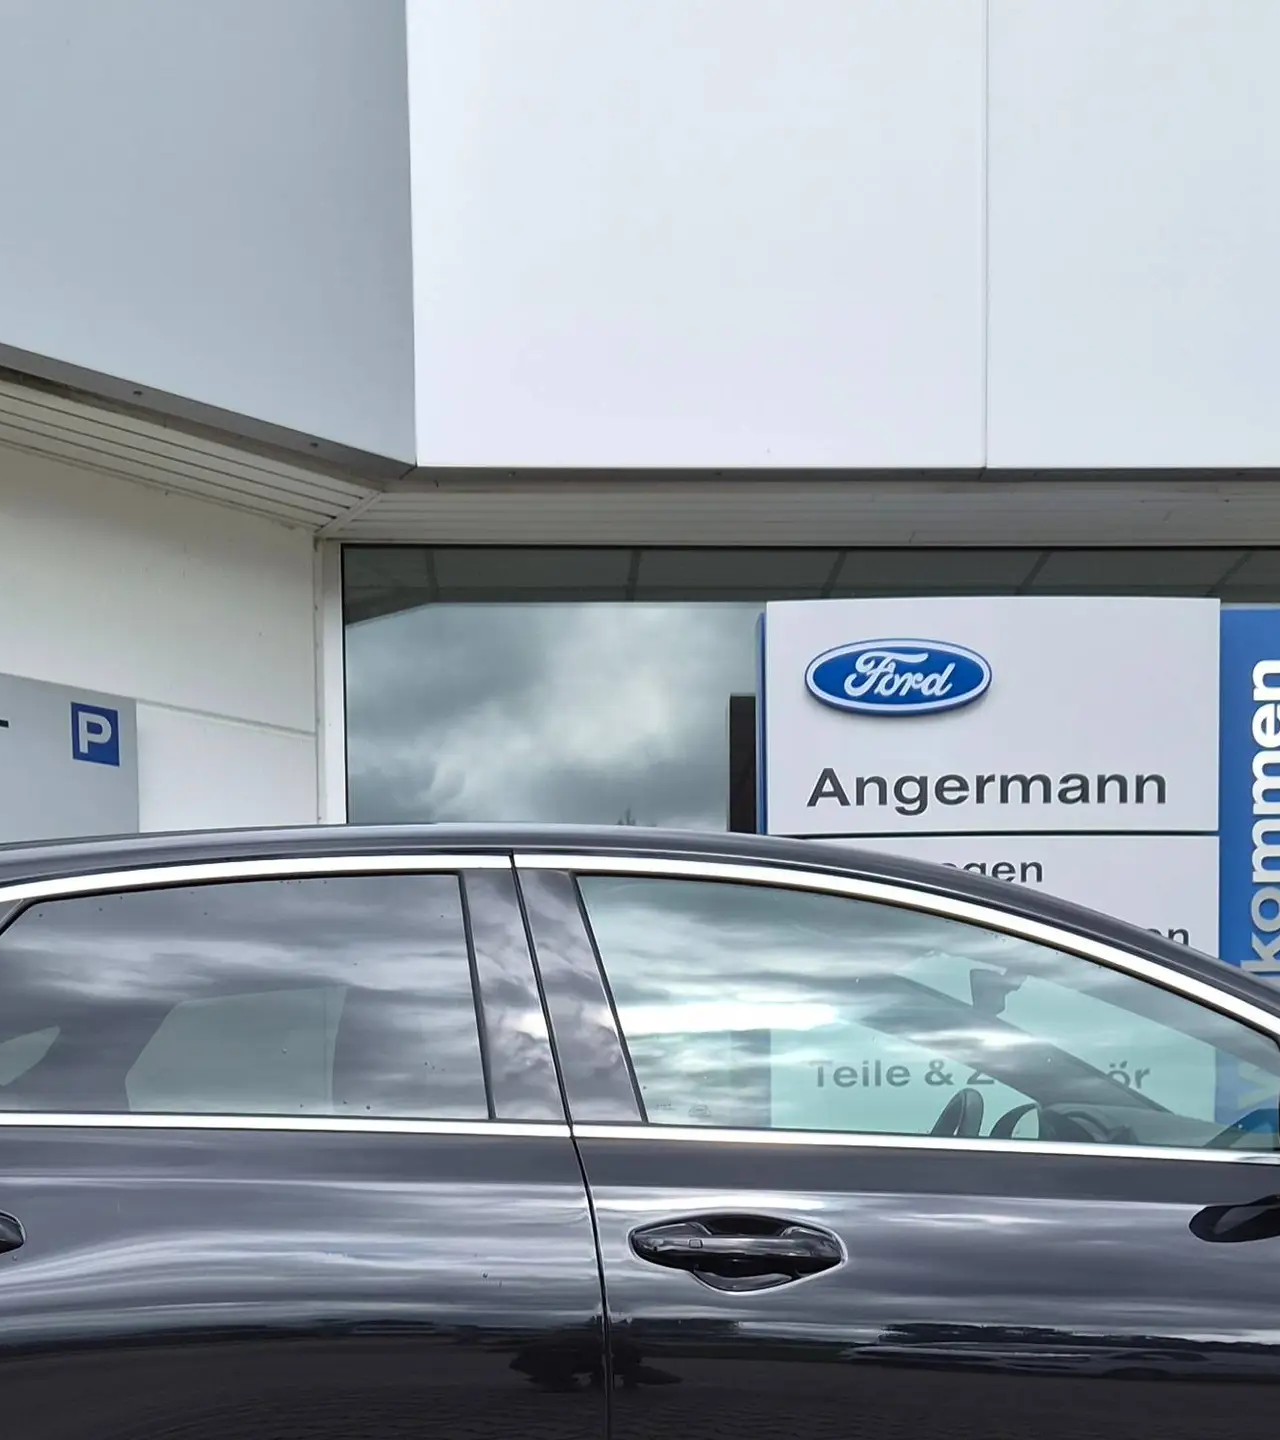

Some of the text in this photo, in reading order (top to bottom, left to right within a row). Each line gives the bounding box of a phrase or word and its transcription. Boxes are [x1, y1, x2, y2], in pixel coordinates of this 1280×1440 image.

[844, 652, 957, 699] Ford
[807, 768, 1167, 815] Angermann
[810, 1059, 911, 1088] Teile
[924, 1060, 955, 1086] &
